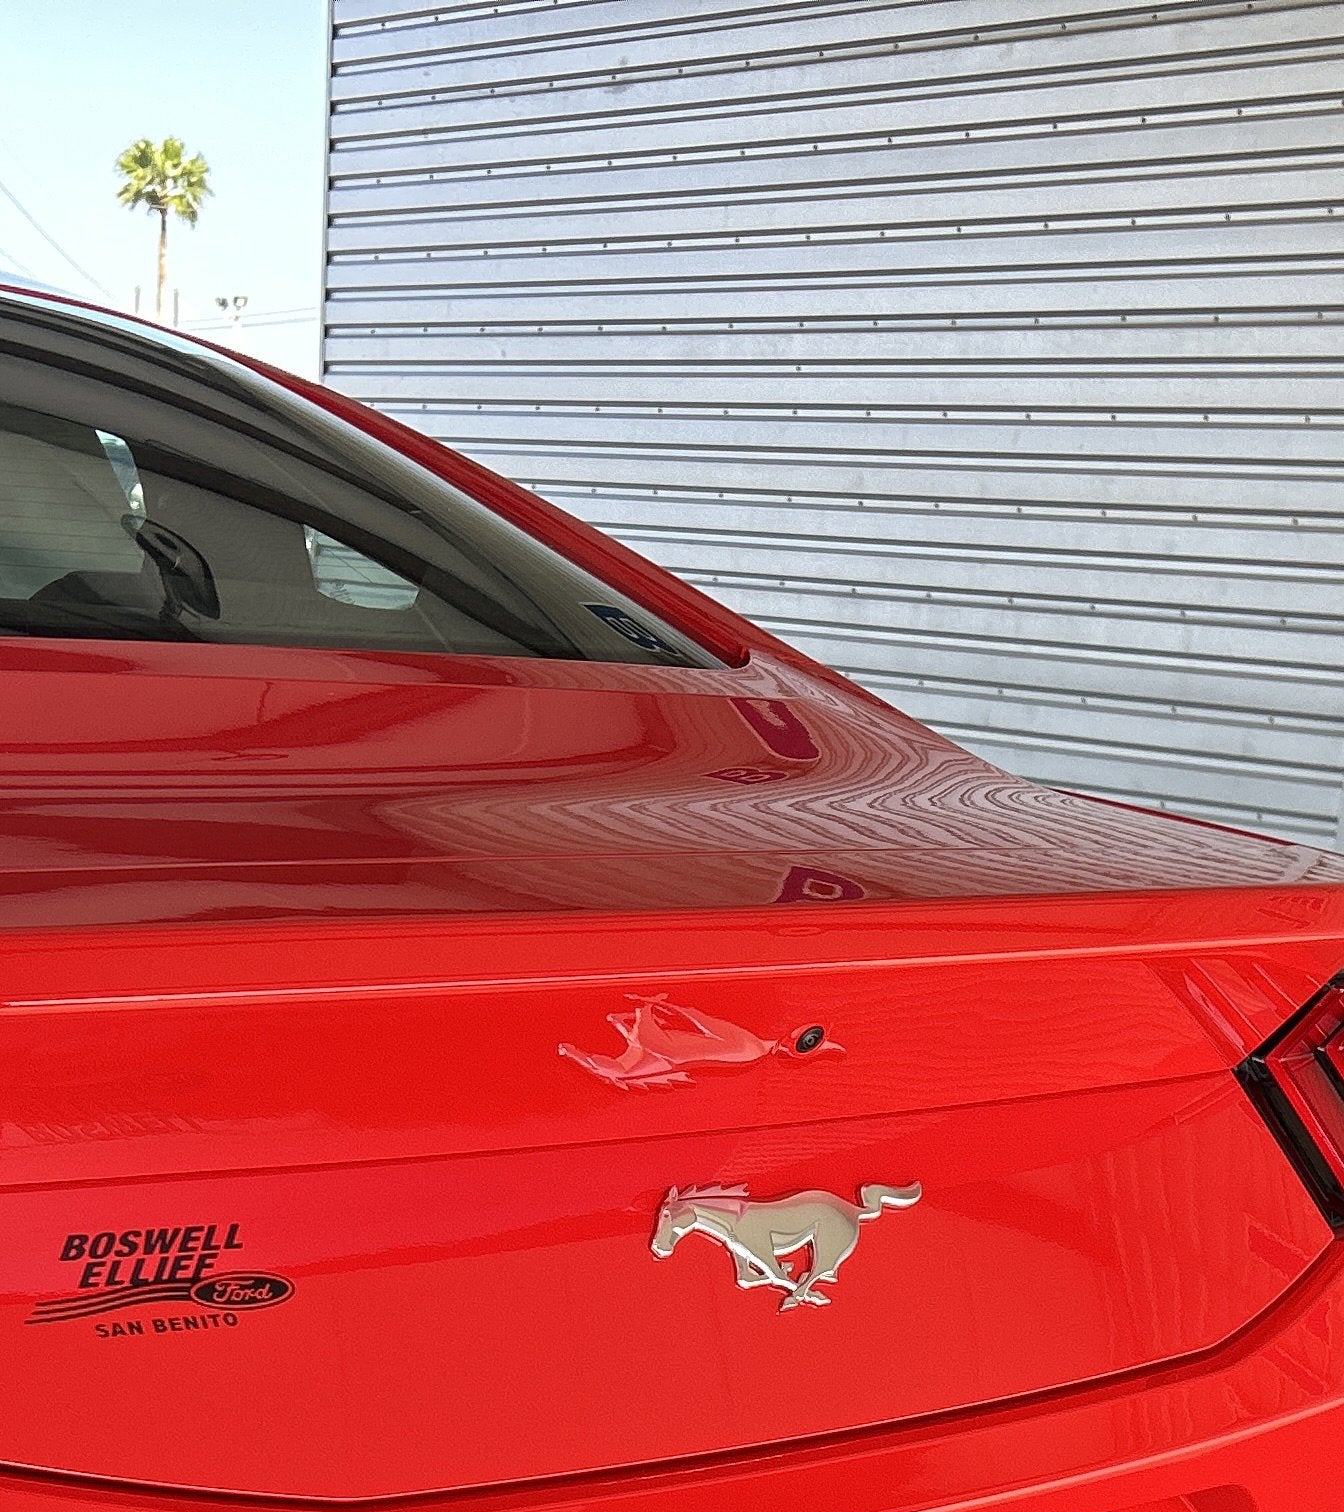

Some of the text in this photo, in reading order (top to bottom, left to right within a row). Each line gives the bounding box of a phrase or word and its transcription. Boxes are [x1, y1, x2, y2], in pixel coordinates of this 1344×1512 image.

[58, 1223, 244, 1262] BOSWELL
[77, 1252, 219, 1289] ELLIFF
[212, 1279, 274, 1303] Ford
[94, 1312, 239, 1339] SAN BENITO
